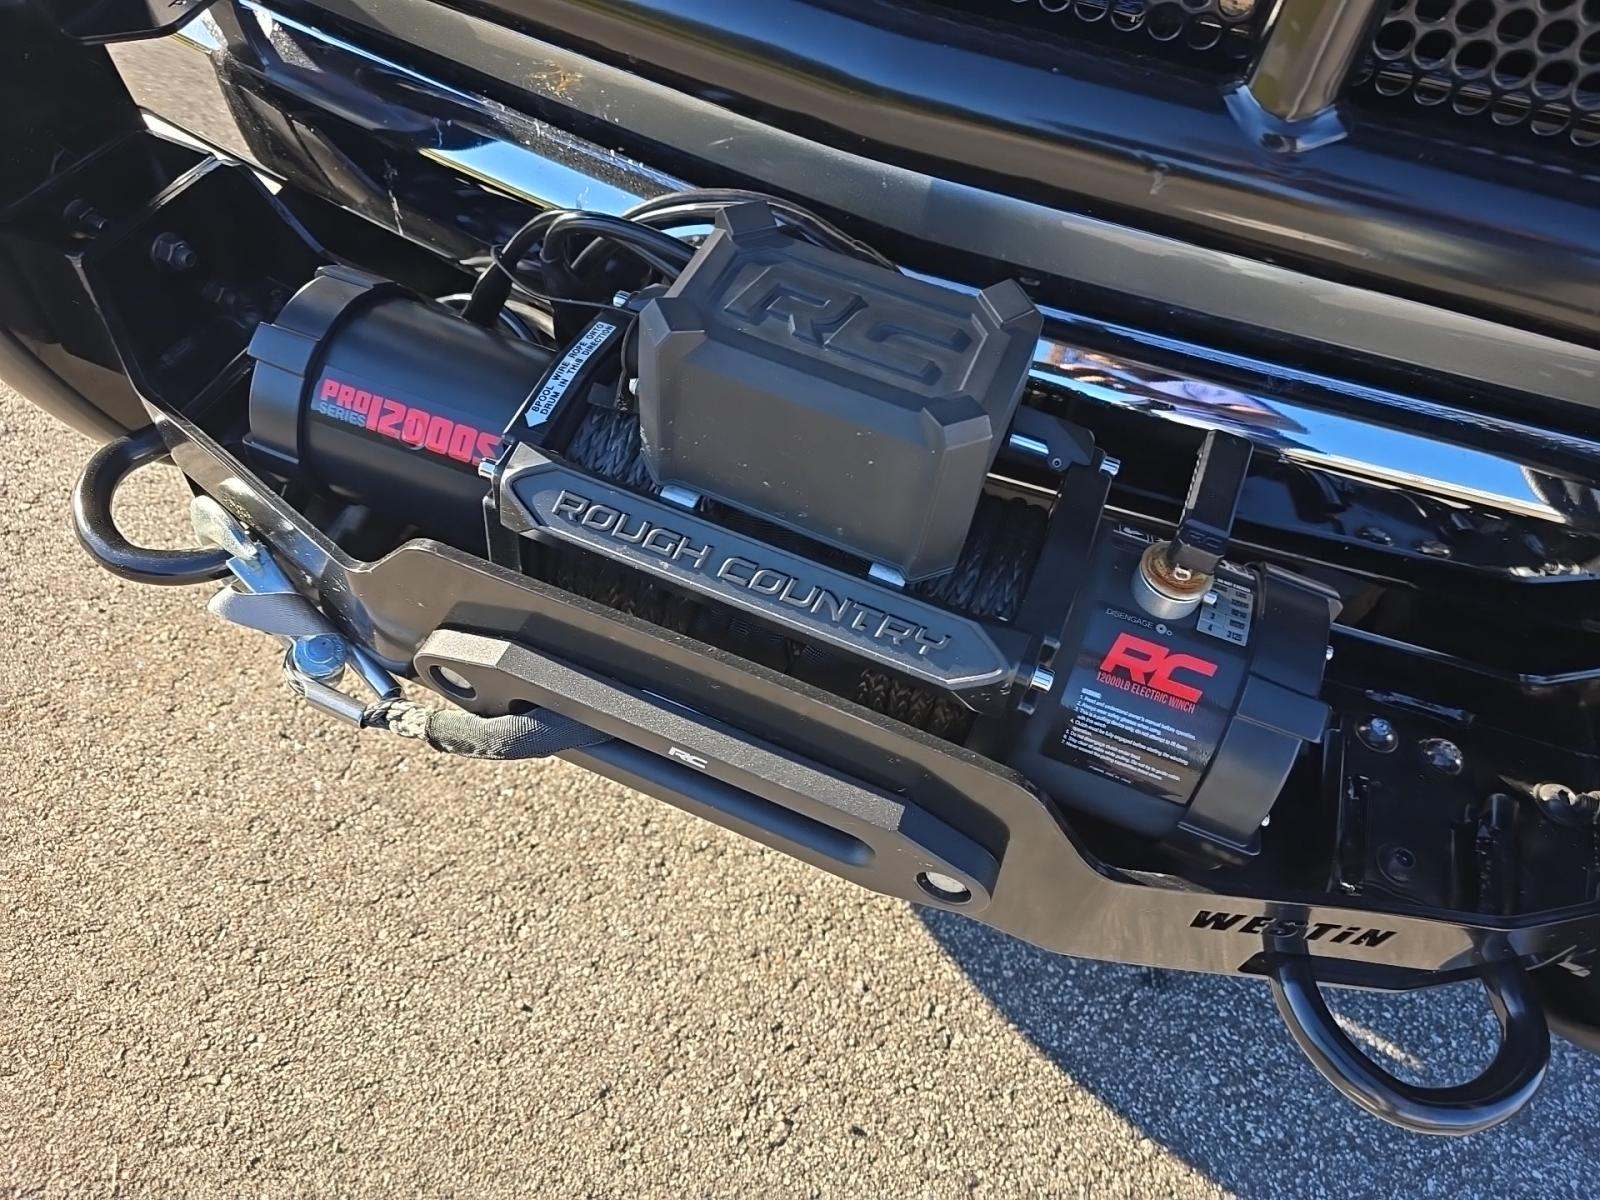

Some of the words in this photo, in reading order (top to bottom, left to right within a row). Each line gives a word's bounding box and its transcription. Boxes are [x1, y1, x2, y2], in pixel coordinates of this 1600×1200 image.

[723, 262, 973, 386] RC
[320, 378, 374, 415] PRO
[531, 385, 555, 413] SPOOL
[551, 361, 571, 381] WIRE
[567, 340, 588, 359] ROPE
[586, 323, 605, 340] ONTO
[539, 391, 561, 416] DRUM
[557, 378, 570, 389] IN
[566, 358, 584, 375] THIS
[581, 325, 614, 357] DIRECTION
[317, 401, 367, 428] SERIES
[552, 489, 714, 569] ROUGH
[716, 555, 951, 656] COUNTRY
[1106, 608, 1154, 629] DISENGAGE
[1097, 671, 1131, 691] 12000LB
[1130, 681, 1169, 706] ELECTRIC
[1168, 695, 1197, 715] WINCH
[1100, 632, 1218, 704] RC
[667, 745, 708, 770] RC
